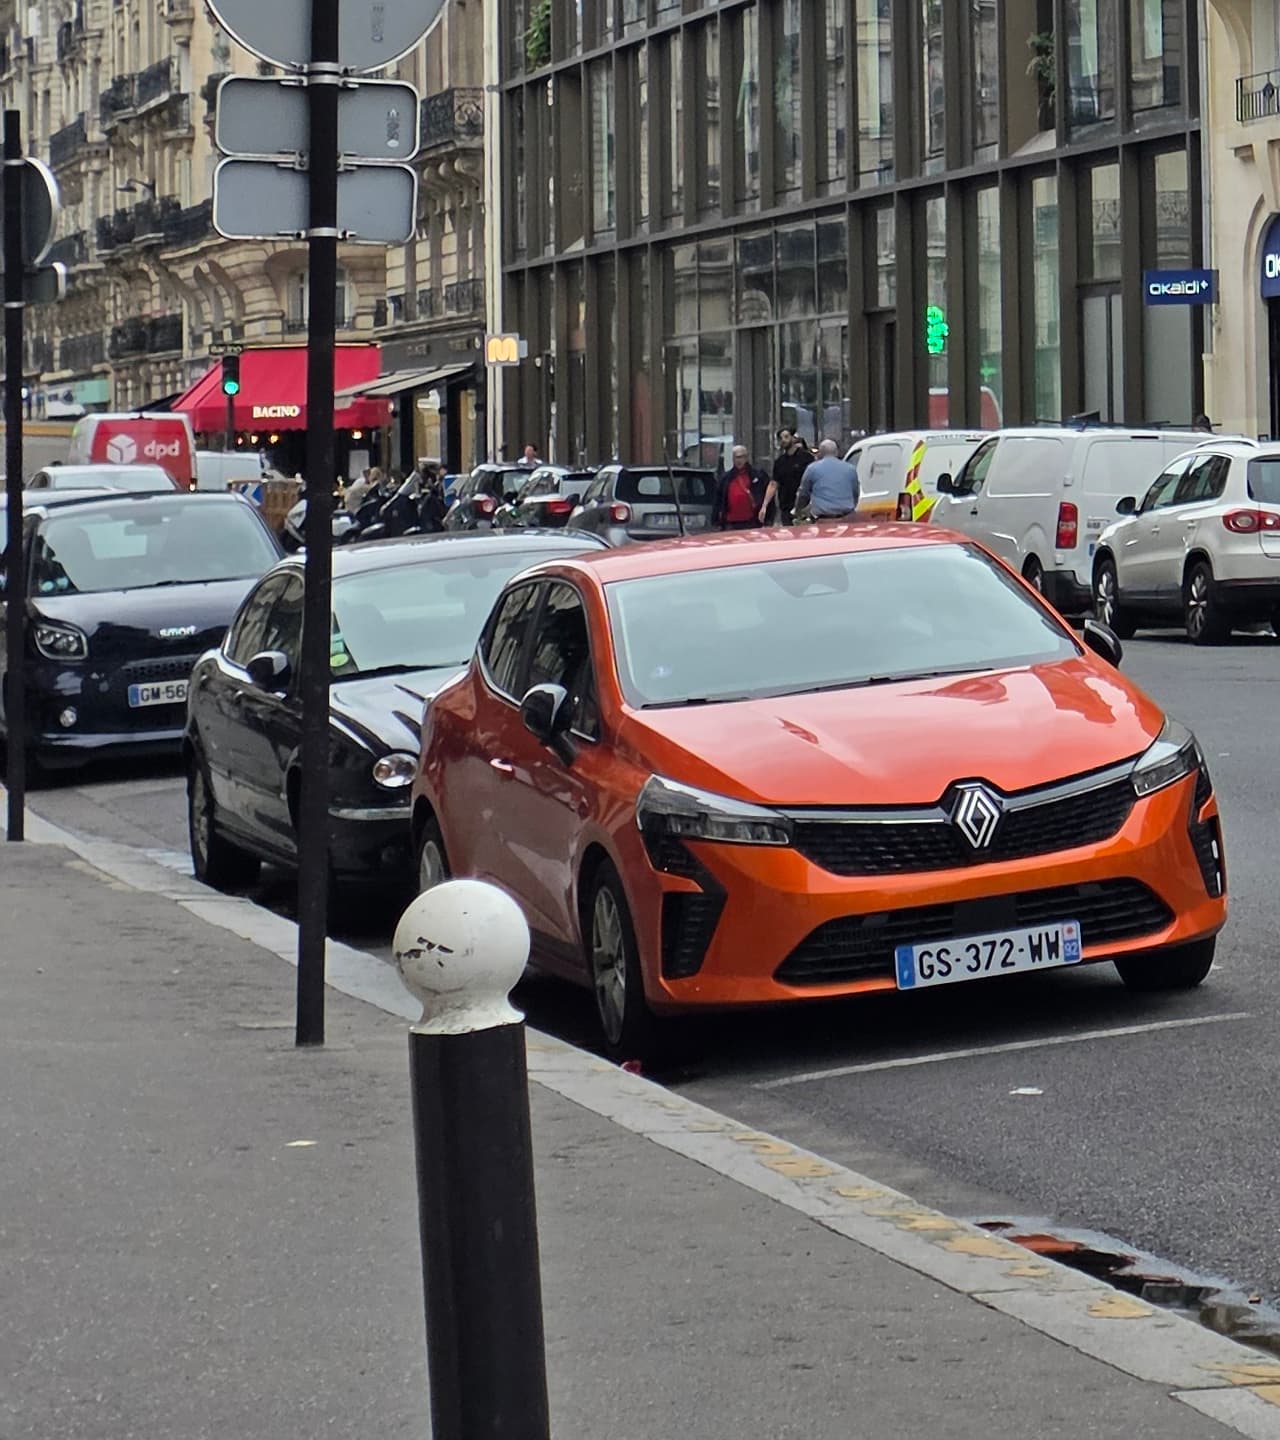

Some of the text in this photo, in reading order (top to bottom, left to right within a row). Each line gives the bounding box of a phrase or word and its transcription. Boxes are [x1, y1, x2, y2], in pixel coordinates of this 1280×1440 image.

[252, 405, 300, 419] BACINO
[143, 439, 180, 460] dpd
[159, 625, 197, 638] smart
[918, 929, 1060, 980] GS-372-WW
[1064, 939, 1079, 956] 92
